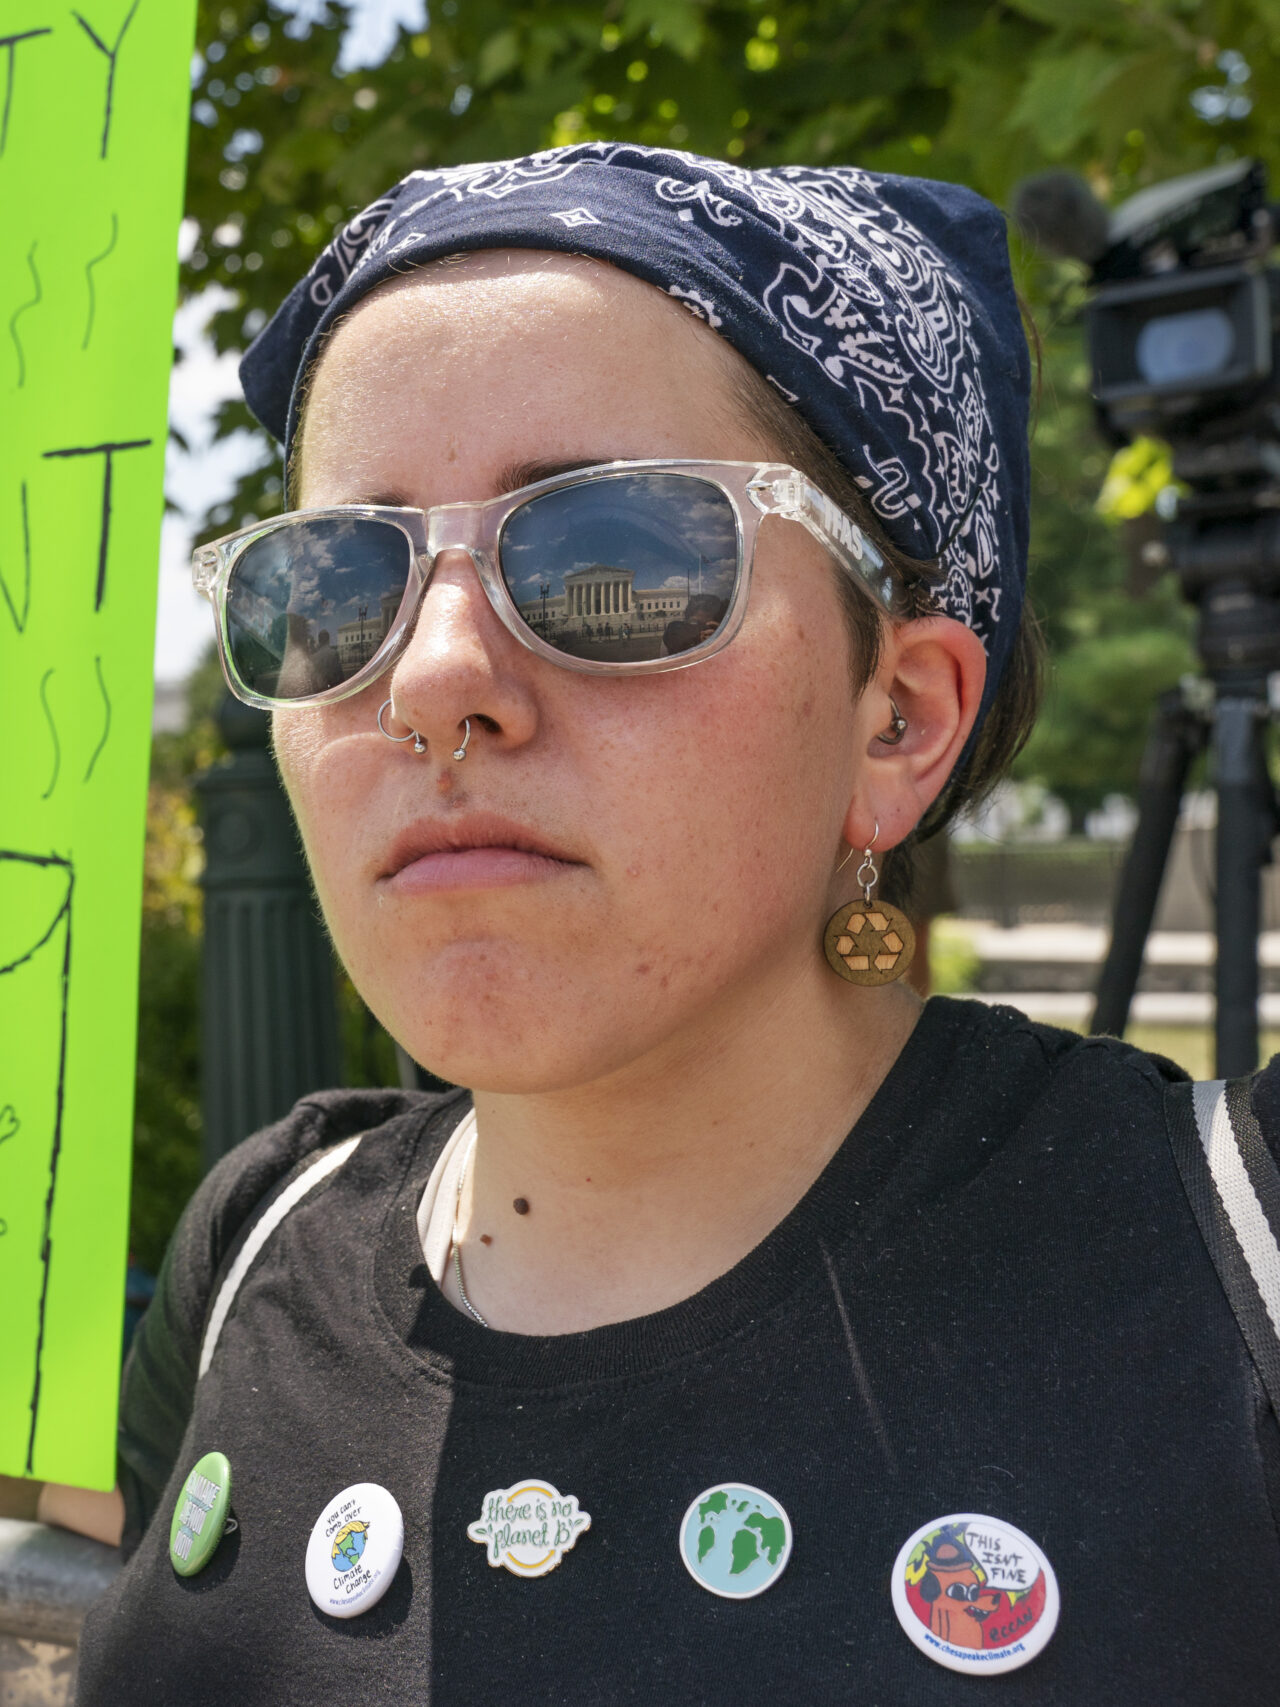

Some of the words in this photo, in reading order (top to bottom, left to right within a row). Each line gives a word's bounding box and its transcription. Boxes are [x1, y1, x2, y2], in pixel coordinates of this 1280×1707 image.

[486, 1496, 532, 1523] there
[535, 1499, 548, 1521] is
[552, 1501, 573, 1518] no
[493, 1522, 550, 1559] planet
[554, 1519, 571, 1546] B
[966, 1532, 1001, 1551] THIS
[333, 1564, 363, 1590] Climate
[990, 1567, 1027, 1585] FINE
[924, 1633, 1026, 1662] www.chesapeakeclimate.org
